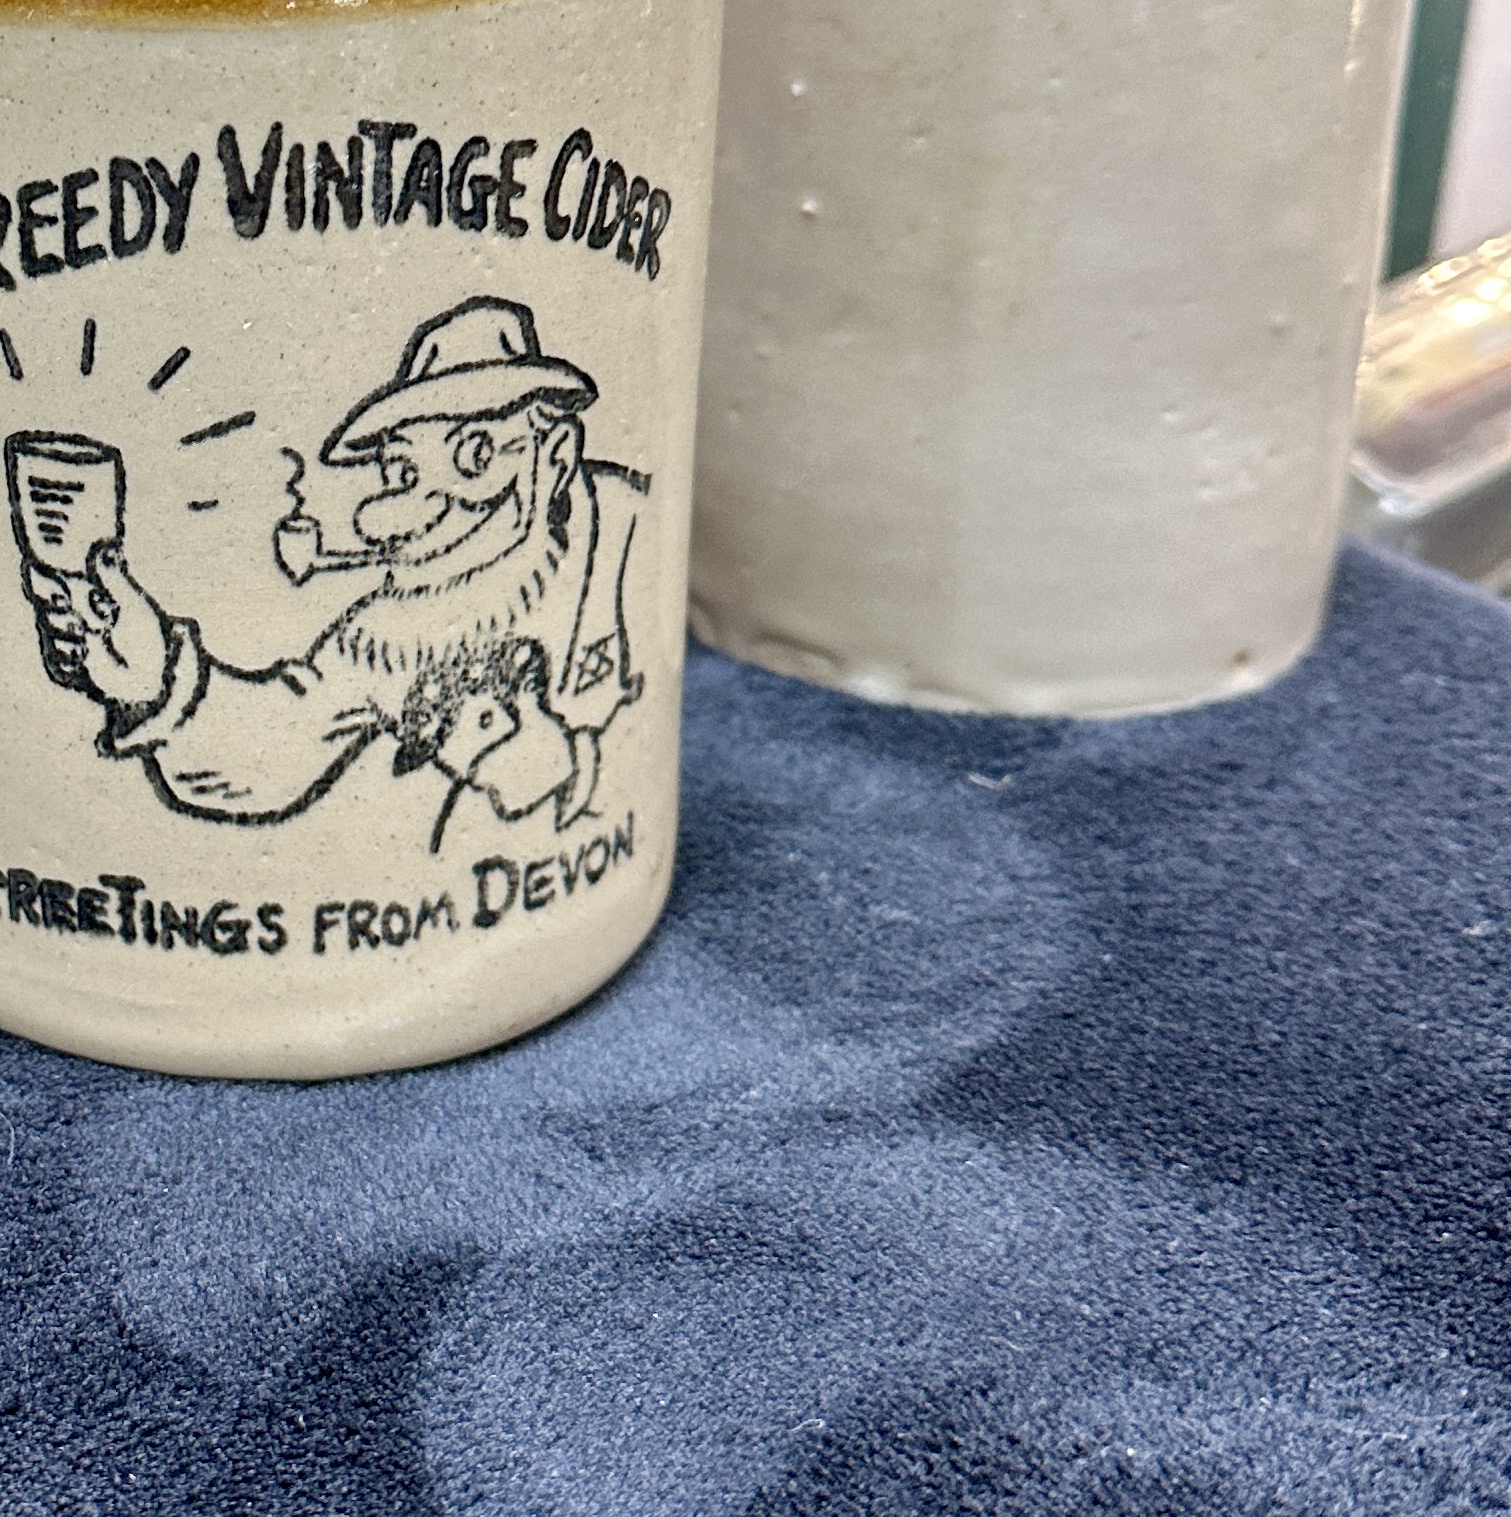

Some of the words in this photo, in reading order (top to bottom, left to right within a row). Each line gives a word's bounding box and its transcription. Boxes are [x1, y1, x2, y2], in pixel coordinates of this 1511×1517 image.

[216, 120, 537, 239] VINTAGE
[542, 127, 673, 280] CIDER
[312, 890, 462, 958] FROM
[472, 810, 636, 931] DEVON
